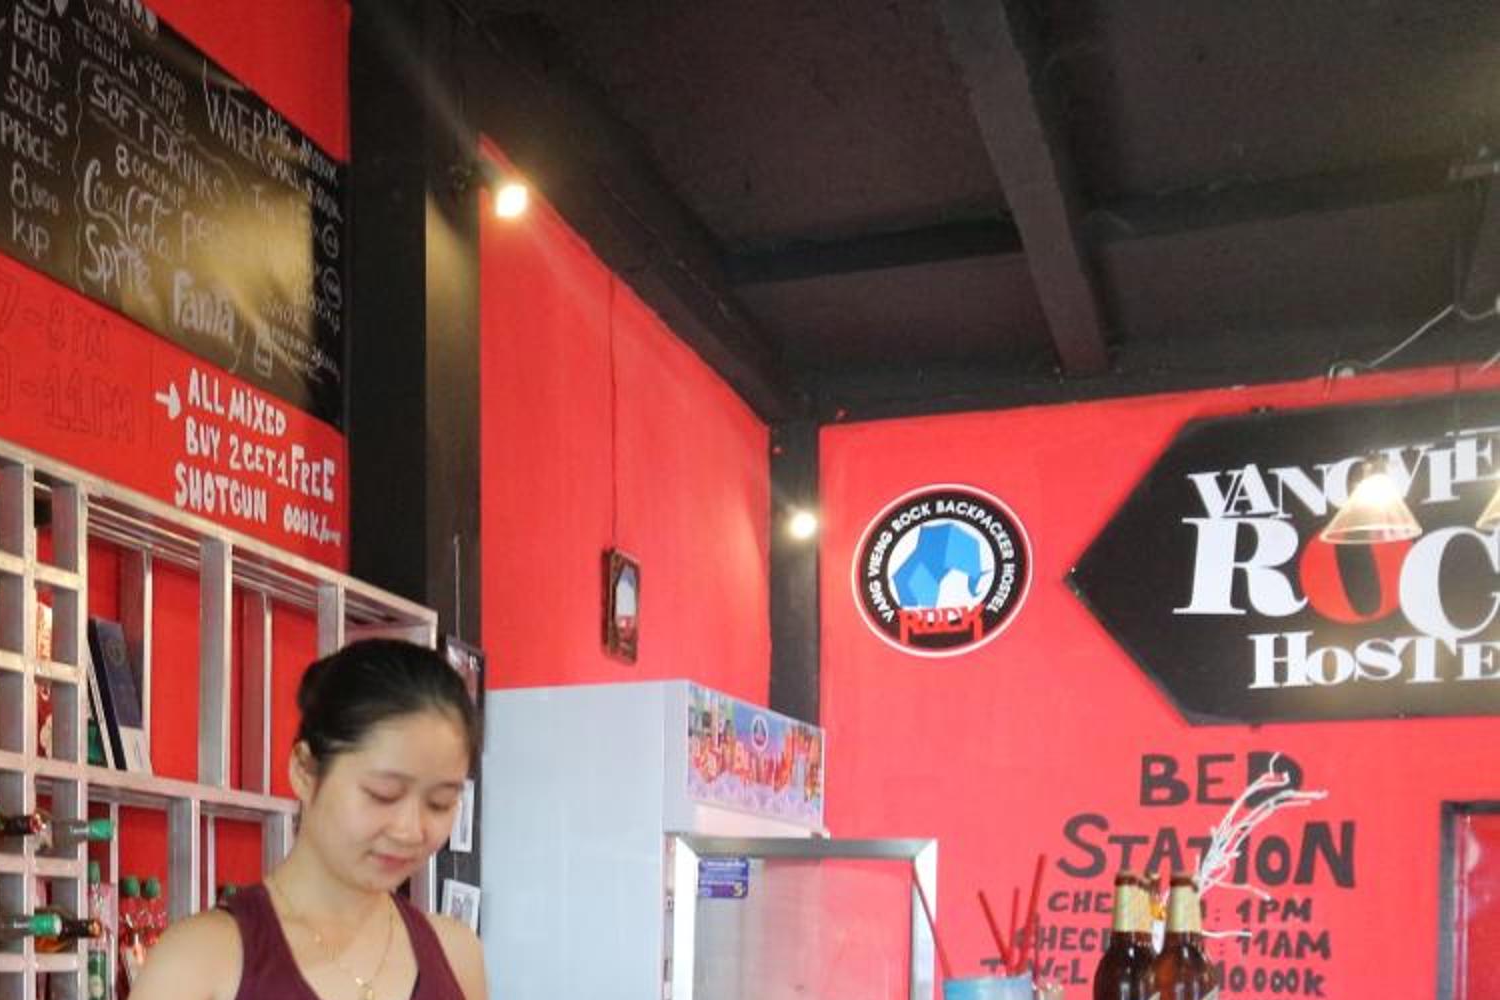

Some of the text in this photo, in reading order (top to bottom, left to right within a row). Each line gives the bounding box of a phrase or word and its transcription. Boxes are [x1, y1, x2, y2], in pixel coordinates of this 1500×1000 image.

[14, 4, 62, 64] BEER
[187, 366, 225, 417] ALL
[185, 415, 221, 464] BUY
[174, 461, 268, 524] SHOTGUN
[868, 499, 1015, 623] VANG VIENG ROCK BACKPACKER HOSTEL
[1140, 751, 1304, 810] BED
